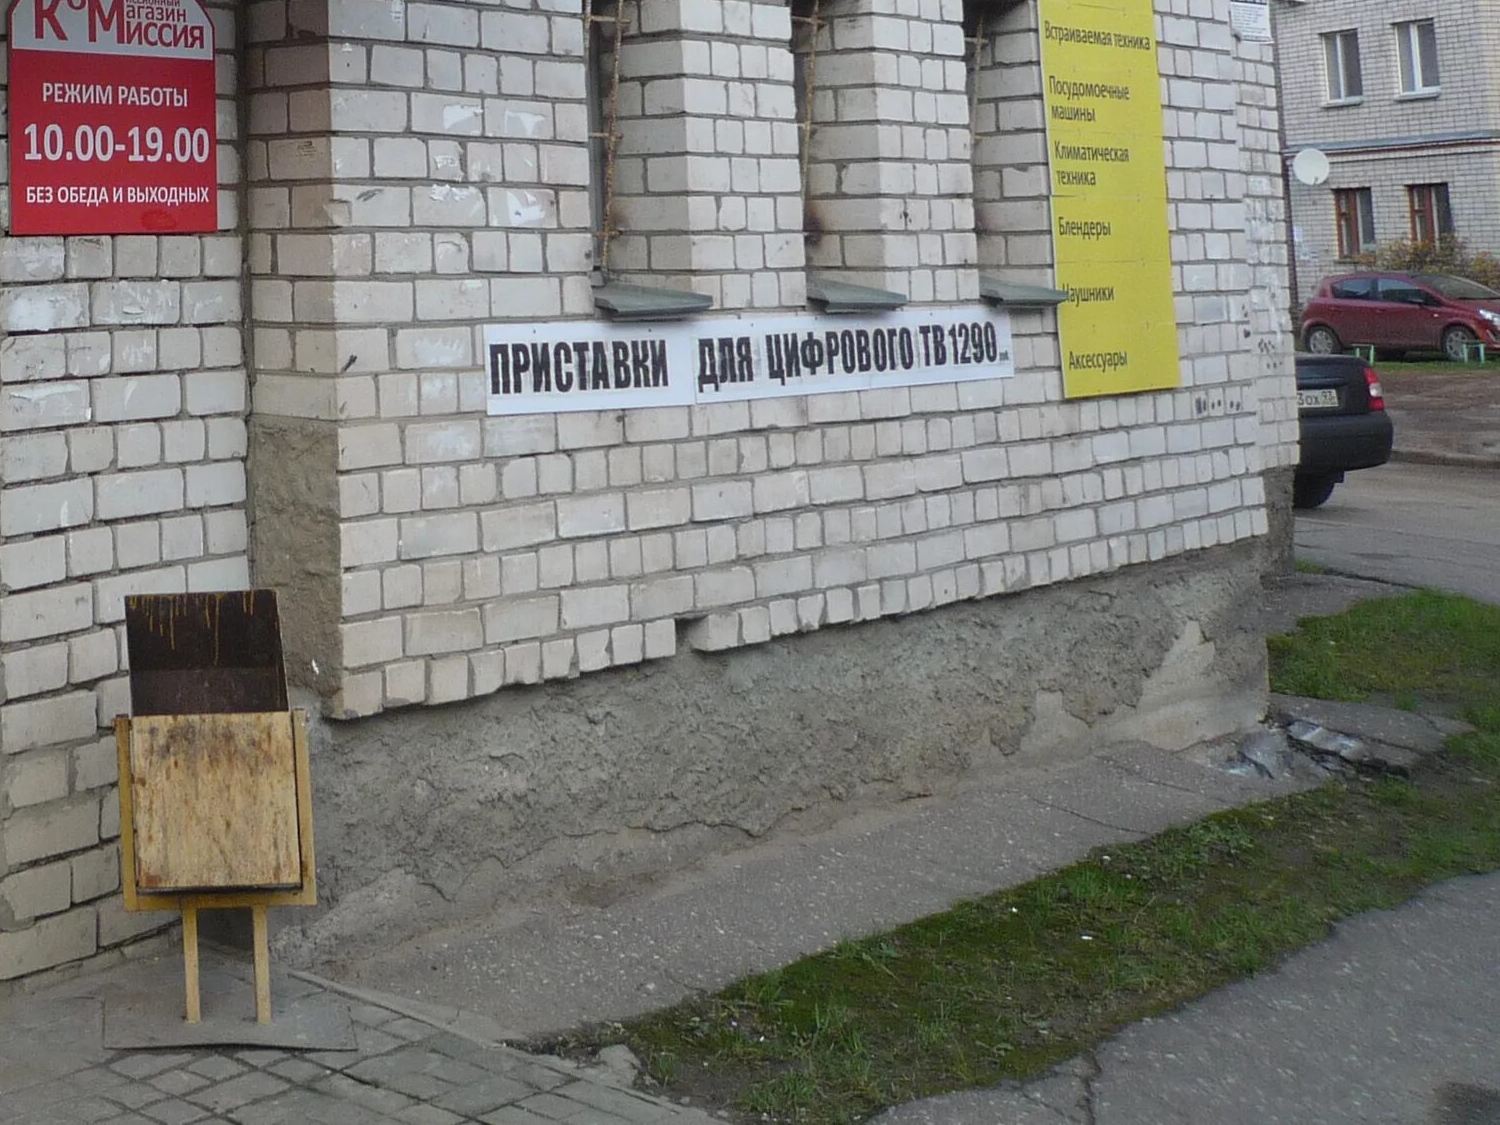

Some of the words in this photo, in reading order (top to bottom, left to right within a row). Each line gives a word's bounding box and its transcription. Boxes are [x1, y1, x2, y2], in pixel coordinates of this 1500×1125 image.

[1044, 20, 1112, 47] Встраиваемая
[1113, 33, 1151, 51] техника
[42, 82, 113, 105] РЕЖИМ
[118, 86, 188, 107] РАБОТЫ
[1049, 75, 1130, 102] Посудомоечные
[1051, 104, 1096, 123] машины
[24, 123, 210, 163] 10.00-19.00
[1054, 140, 1130, 163] Климатическая
[1056, 169, 1097, 187] техника
[26, 186, 53, 203] БЕЗ
[57, 186, 109, 206] ОБЕДА
[113, 187, 124, 203] И
[127, 187, 210, 206] ВЫХОДНЫХ
[1058, 216, 1112, 241] Блендеры
[489, 339, 669, 396] ПРИСТАВКИ
[697, 336, 753, 393] ДЛЯ
[765, 325, 915, 386] ЦИФРОВОГО
[919, 323, 947, 368] ТВ
[948, 321, 998, 365] 1290
[1068, 350, 1128, 374] Аксессуары
